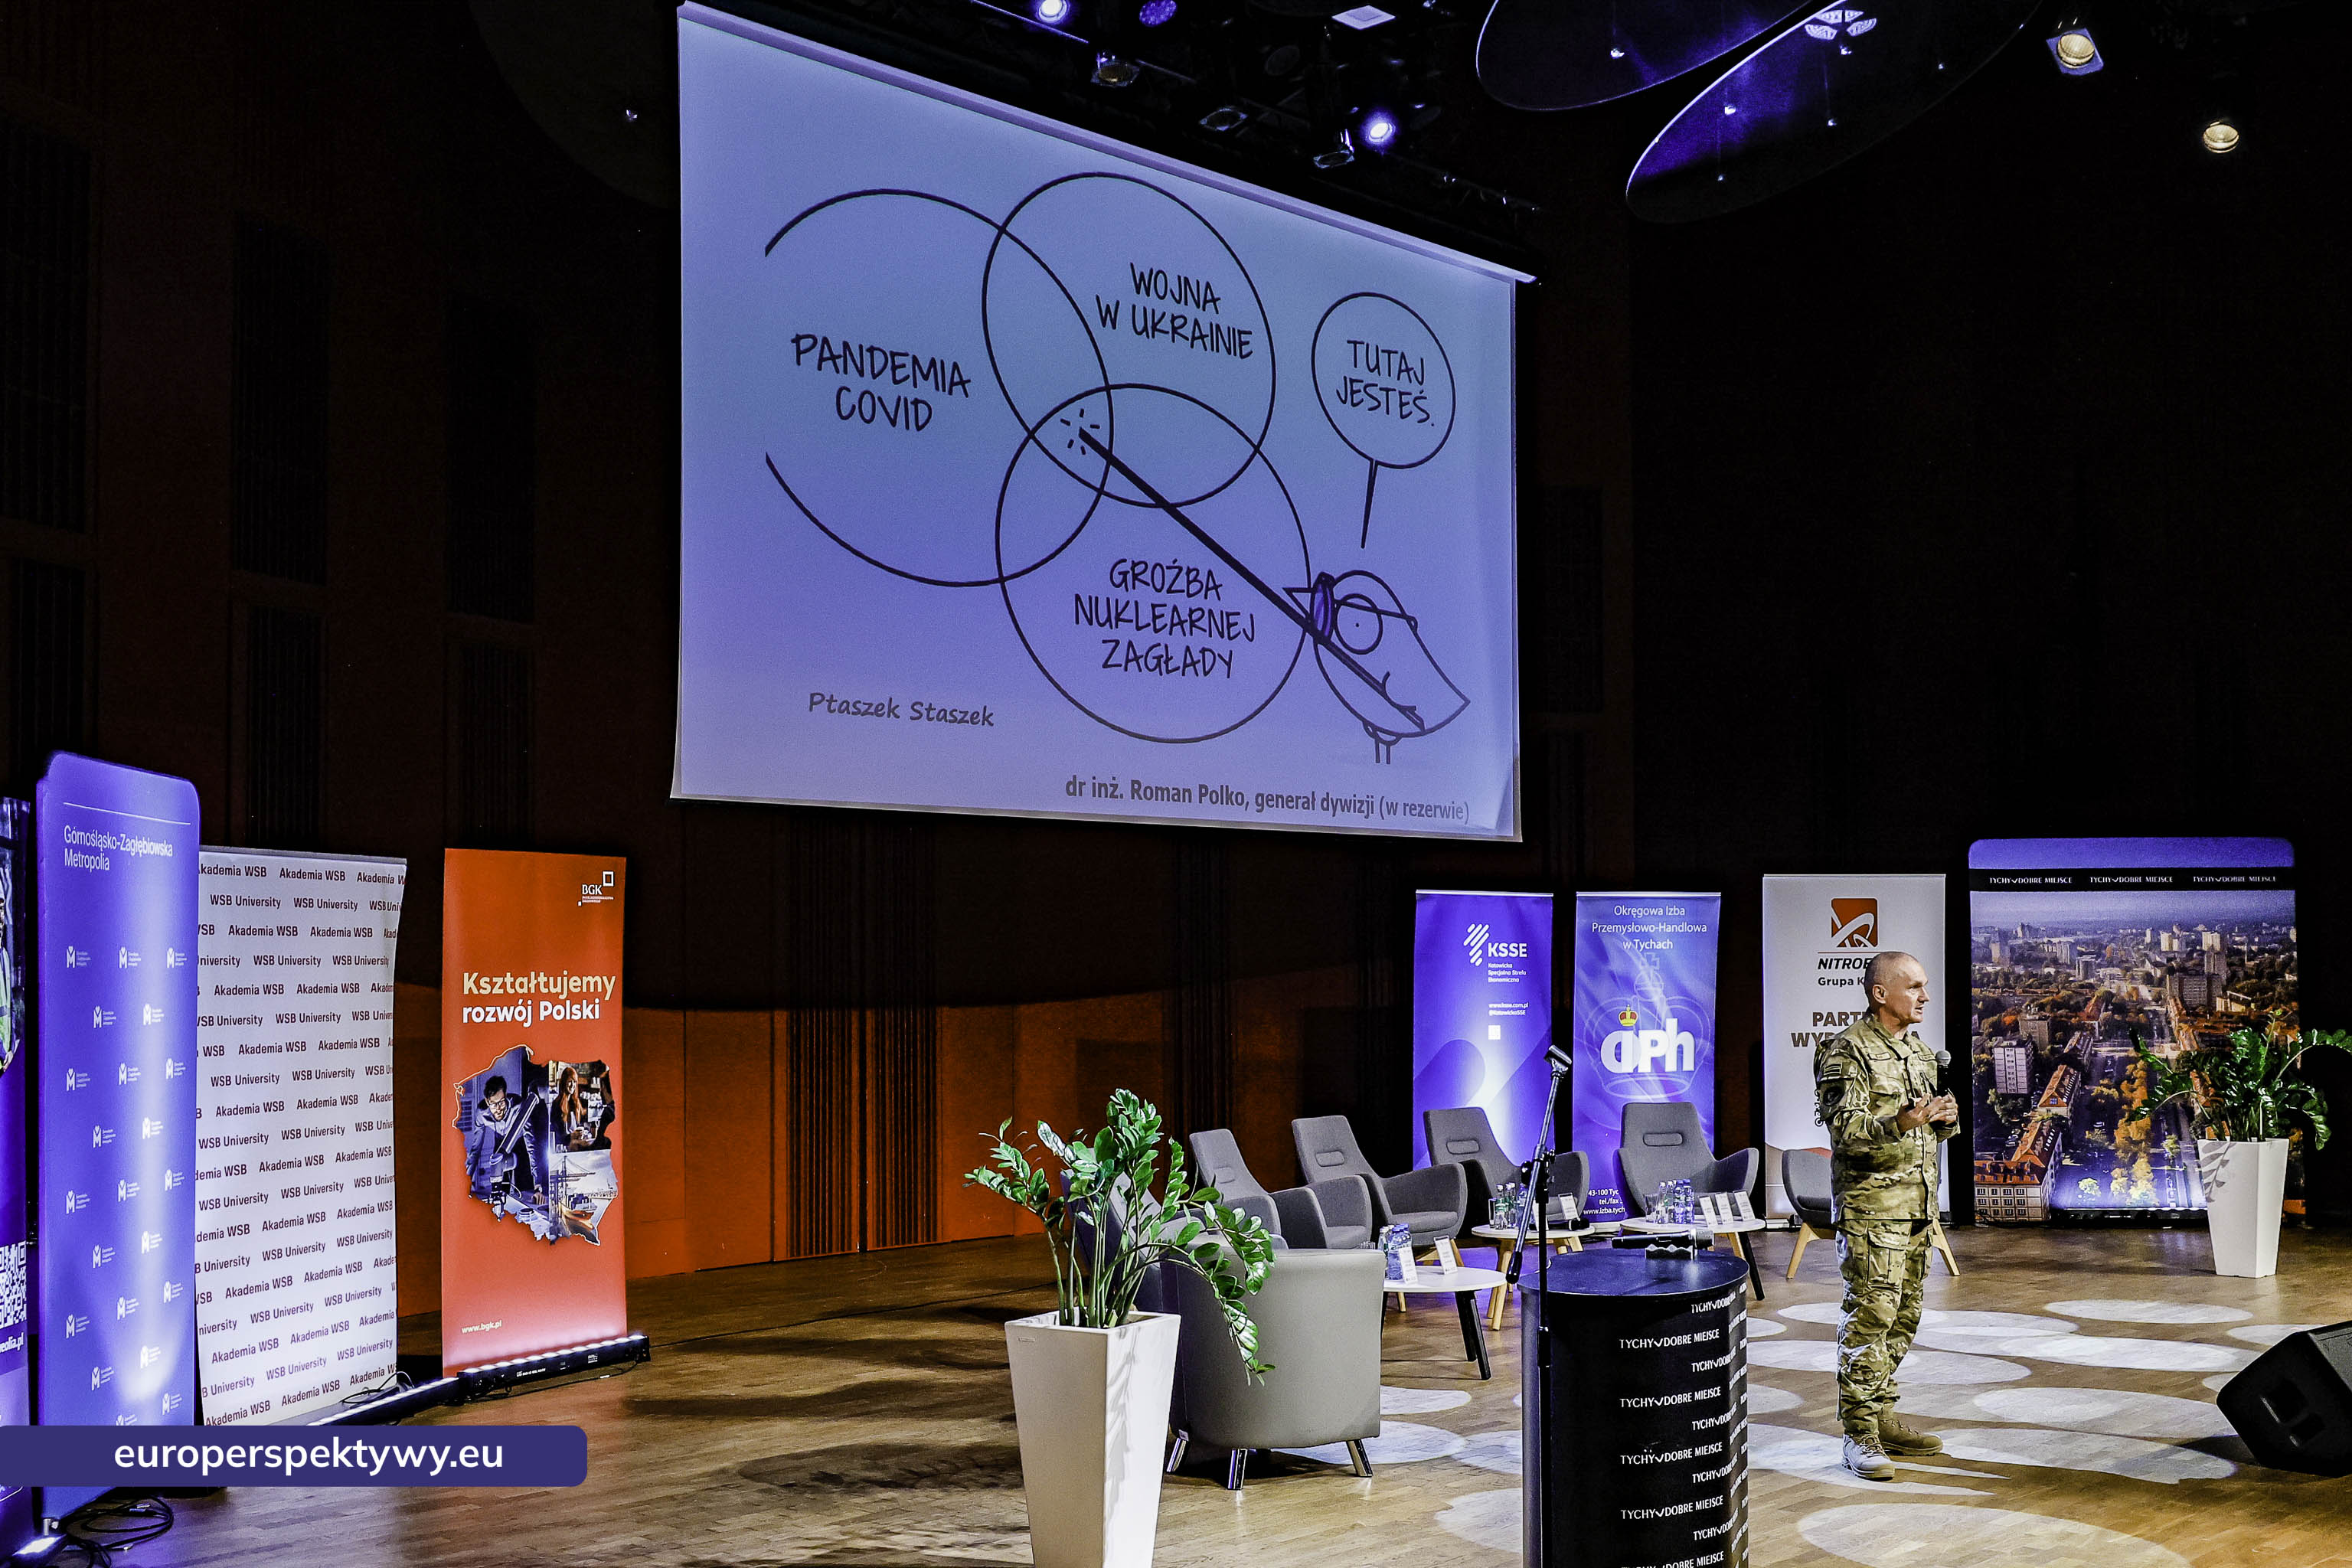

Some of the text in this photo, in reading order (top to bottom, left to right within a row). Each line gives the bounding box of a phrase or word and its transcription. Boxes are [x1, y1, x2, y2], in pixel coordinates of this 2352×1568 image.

[1130, 263, 1220, 316] WOJNA
[1096, 295, 1253, 359] W UKRAINIE
[791, 334, 971, 401] PANDEMIA
[1347, 340, 1424, 387] TUTAJ
[836, 383, 936, 432] COVID
[1336, 373, 1434, 426] JESTEŚ.
[1110, 558, 1223, 603] GROŹBA
[1075, 599, 1254, 646] NUKLEARNEJ
[1102, 639, 1232, 678] ZAGŁADY
[809, 693, 994, 727] Ptaszek Staszek
[1066, 774, 1469, 825] dr inż. Roman Polko, generał dywizji (w rezerwie)
[64, 825, 173, 858] Górnośląsko-Zagłębiowska
[64, 849, 109, 873] Metropolia
[245, 866, 394, 884] WSB Akademia WSB Akademia
[211, 894, 386, 912] WSB University WSB University WSB
[583, 884, 602, 895] BGK
[1615, 906, 1685, 916] Okręgowa Izba
[1592, 923, 1707, 934] Przemysłowo-Handlowa
[1488, 942, 1527, 957] KSSE
[1633, 939, 1673, 950] Tychach
[253, 956, 274, 965] WSB
[278, 956, 321, 967] University
[333, 956, 351, 965] WSB
[214, 983, 359, 995] Akademia WSB Akademia WSB
[463, 970, 616, 1000] Kształtujemy
[1818, 978, 1854, 988] Grupa
[217, 1011, 370, 1027] University WSB University WSB
[462, 998, 599, 1027] rozwój Polski
[1813, 1012, 1865, 1027] PART
[203, 1038, 380, 1057] WSB Akademia WSB Akademia WSB
[211, 1066, 384, 1086] WSB University WSB University WSB
[199, 1122, 373, 1149] WSB University WSB University WSB
[224, 1146, 391, 1176] WSB Akademia WSB Akademia WSB
[199, 1177, 371, 1210] WSB University WSB University WSB
[227, 1200, 392, 1236] WSB Akademia WSB Akademia WSB
[204, 1230, 392, 1272] University WSB University WSB University
[226, 1262, 362, 1298] Akademia WSB Akademia WSB
[212, 1312, 394, 1364] Akademia WSB Akademia WSB Akademia
[462, 1320, 501, 1334] www.bgk.pl
[1619, 1329, 1720, 1349] TYCHY DOBRE MIEJSCE
[211, 1339, 393, 1395] University WSB University WSB University
[250, 1369, 384, 1415] WSB Akademia WSB Akademia
[1620, 1387, 1721, 1408] TYCHY DOBRE MIEJSCE
[1621, 1442, 1722, 1464] TYCHY DOBRE MIEJSCE
[1621, 1495, 1723, 1520] TYCHY DOBRE MIEJSCE
[1697, 1551, 1724, 1566] MIEJSCE
